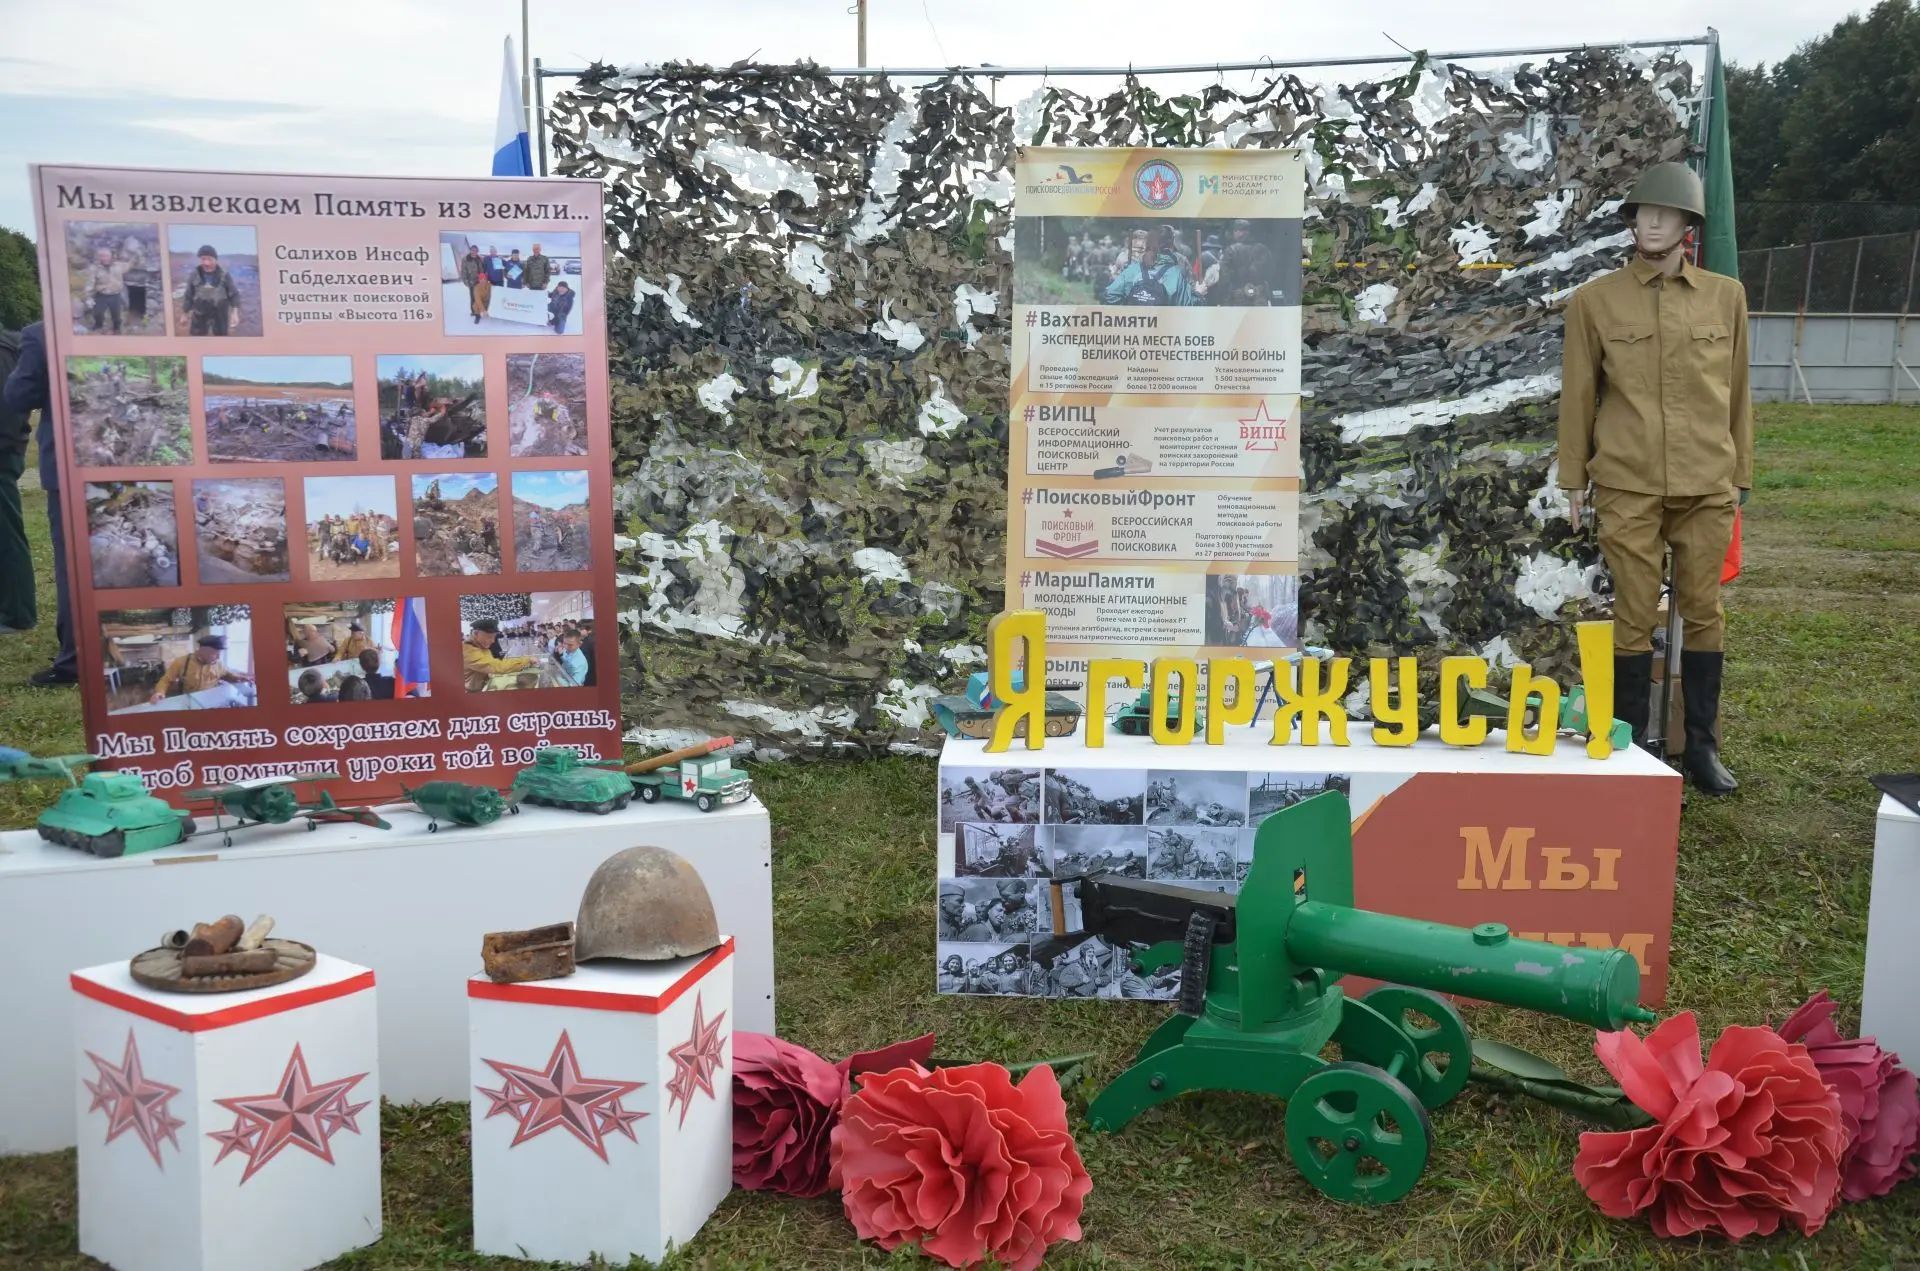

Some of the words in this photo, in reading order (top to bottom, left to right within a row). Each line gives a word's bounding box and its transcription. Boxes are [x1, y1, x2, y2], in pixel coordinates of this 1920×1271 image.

[56, 184, 115, 211] Мы
[128, 193, 302, 215] извлекаем
[314, 193, 426, 218] Память
[437, 201, 471, 219] из
[483, 202, 590, 221] земли...
[275, 245, 358, 261] Салихов
[365, 246, 430, 266] Инсаф
[279, 269, 414, 287] Габделхаевич
[279, 293, 348, 306] участник
[353, 291, 430, 303] поисковой
[278, 311, 333, 323] группы
[338, 308, 398, 321] «Высота
[403, 309, 433, 320] 116»
[1041, 334, 1120, 348] ЭКСПЕДИЦИИ
[1123, 335, 1140, 346] НА
[1142, 335, 1182, 347] МЕСТА
[1184, 335, 1215, 347] БОЕВ
[1081, 347, 1136, 361] ВЕЛИКОЙ
[1139, 347, 1239, 362] ОТЕЧЕСТВЕННОЙ
[1242, 348, 1286, 362] ВОЙНЫ
[1040, 365, 1078, 373] Проведено
[1127, 366, 1159, 374] Найдены
[1038, 427, 1120, 437] ВСЕРОССИЙСКИЙ
[1239, 426, 1287, 441] ВИПЦ
[1038, 440, 1134, 449] ИНФОРМАЦИОННО-
[1037, 450, 1099, 460] ПОИСКОВЫЙ
[1037, 462, 1068, 471] ЦЕНТР
[1217, 494, 1252, 502] Обучение
[1041, 520, 1094, 531] ПОИСКОВЫЙ
[1111, 516, 1193, 526] ВСЕРОССИЙСКАЯ
[1256, 520, 1282, 528] работы
[1053, 532, 1082, 542] ФРОНТ
[1111, 530, 1147, 539] ШКОЛА
[1195, 532, 1234, 541] Подготовку
[1111, 542, 1177, 552] ПОИСКОВИКА
[1034, 593, 1105, 604] МОЛОДЕЖНЫЕ
[1107, 595, 1187, 606] АГИТАЦИОННЫЕ
[1034, 607, 1076, 619] ОХОДЫ
[1096, 607, 1130, 616] Проходят
[1131, 608, 1164, 616] ежегодно
[1124, 626, 1151, 634] встречи
[1079, 634, 1139, 642] патриотического
[982, 609, 1046, 753] Я
[97, 733, 155, 759] Мы
[163, 727, 277, 751] Память
[285, 718, 441, 750] сохраняем
[447, 715, 500, 739] для
[507, 709, 616, 737] страны,
[348, 753, 436, 782] уроки
[443, 743, 494, 769] той
[1456, 826, 1622, 891] Мы
